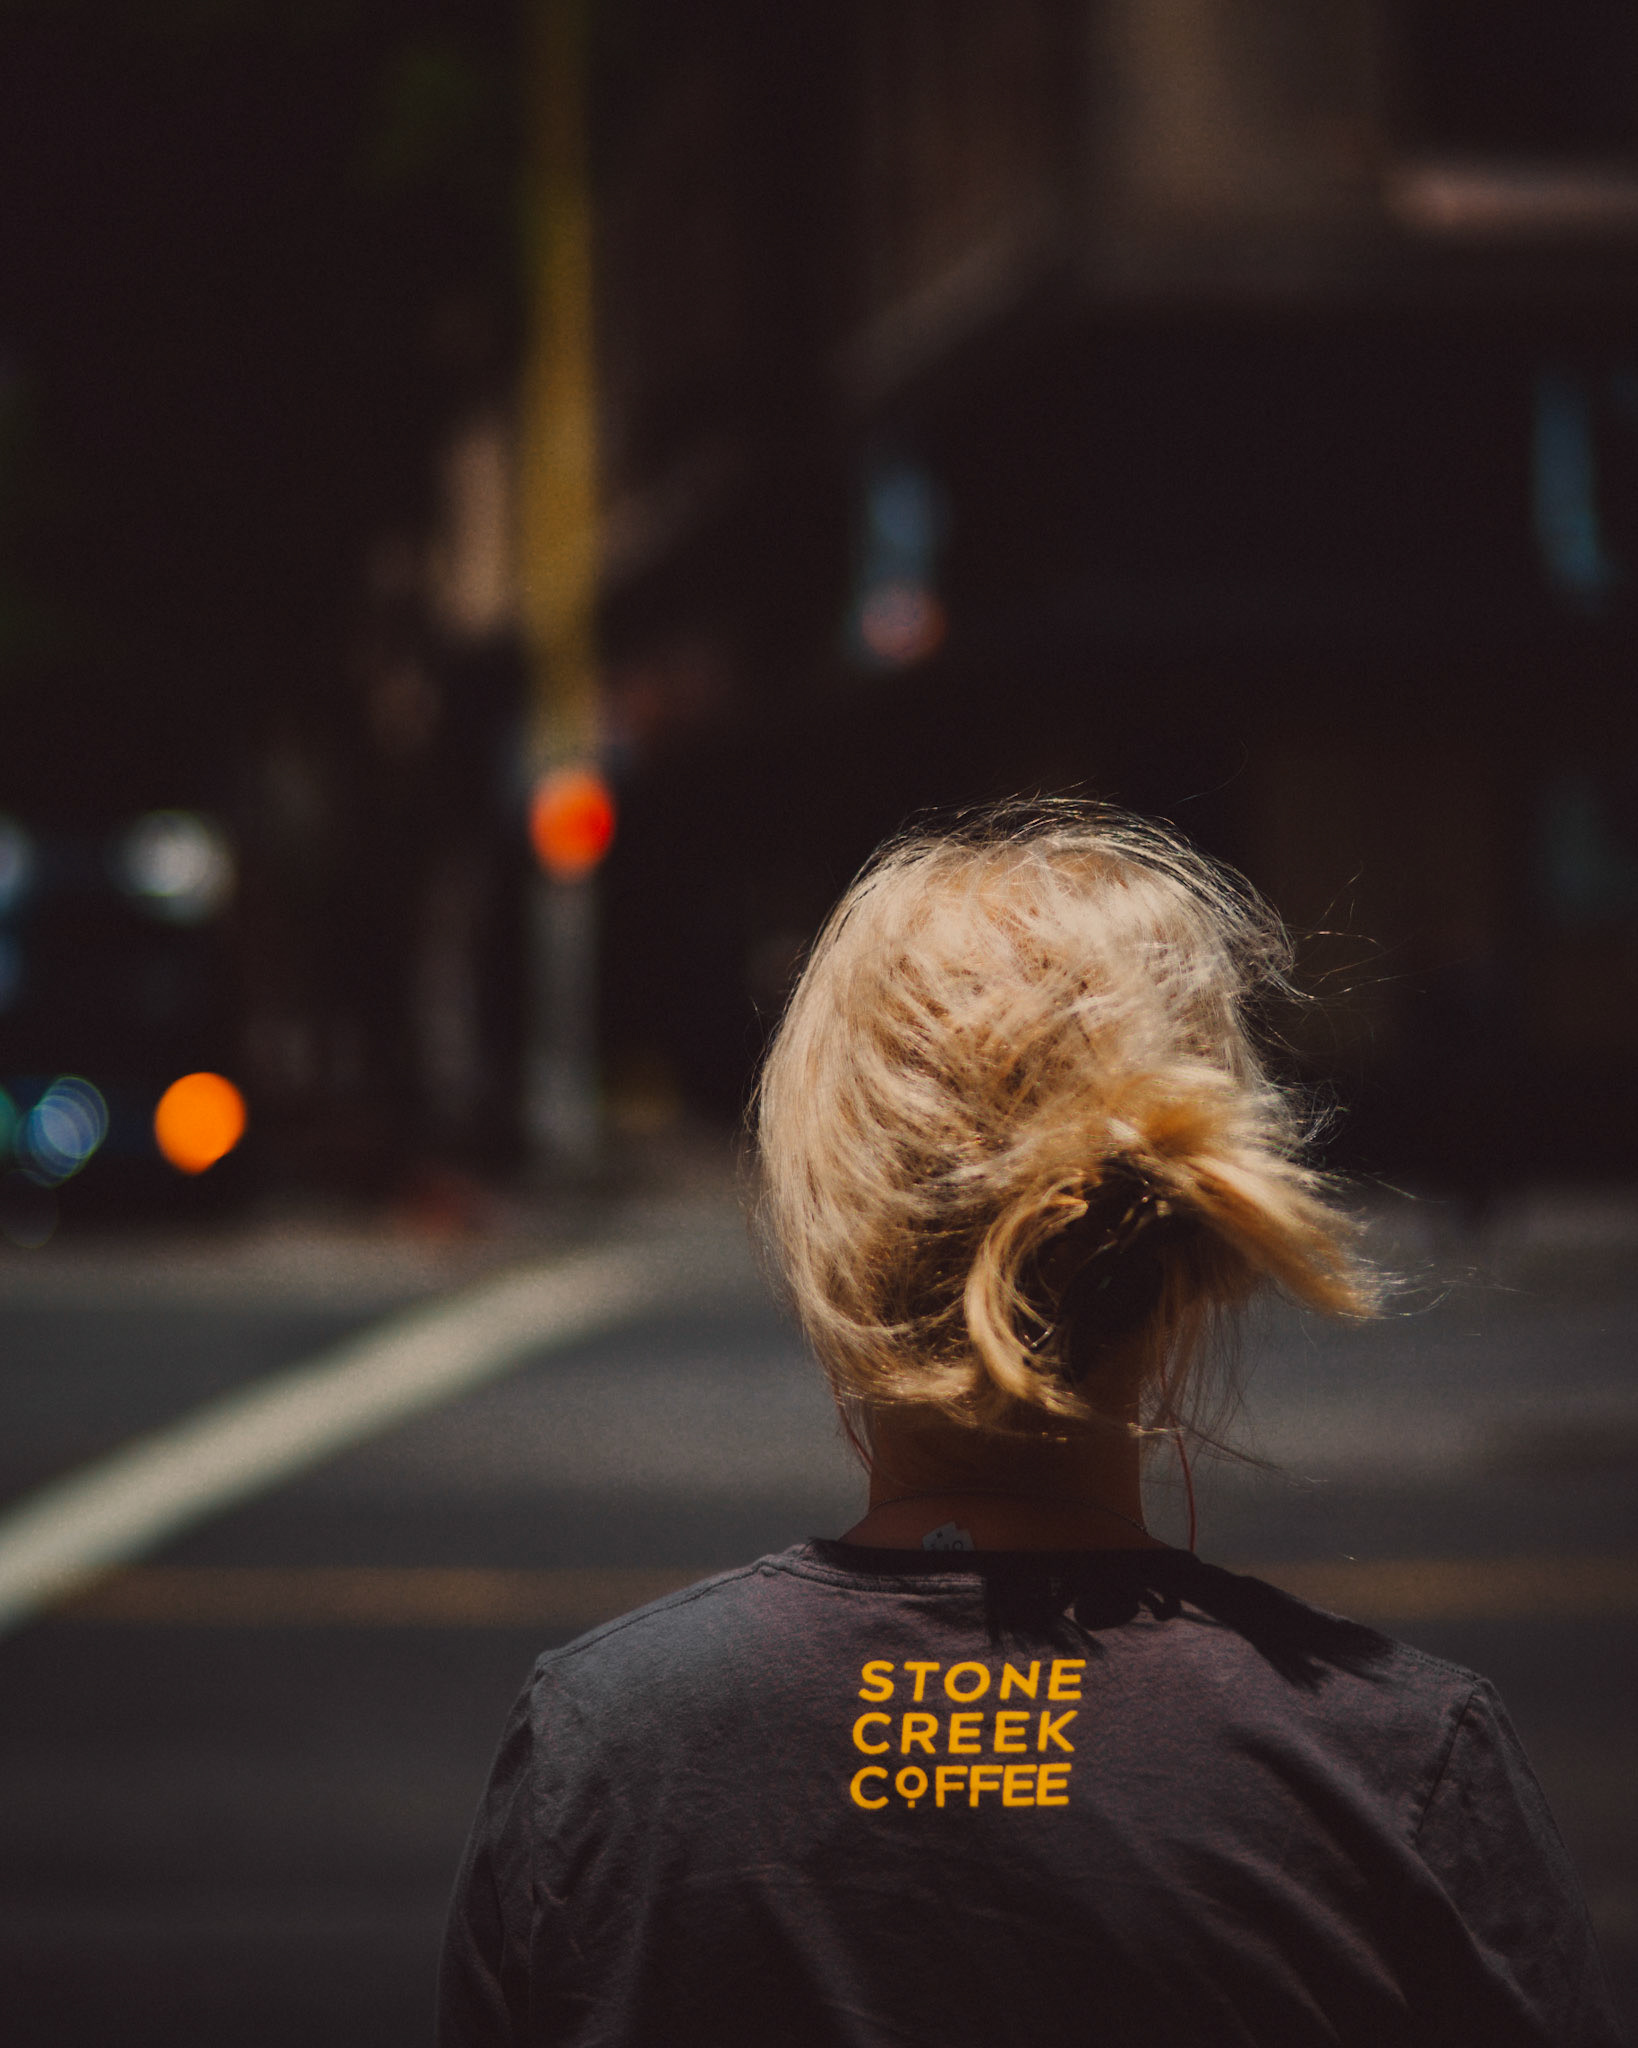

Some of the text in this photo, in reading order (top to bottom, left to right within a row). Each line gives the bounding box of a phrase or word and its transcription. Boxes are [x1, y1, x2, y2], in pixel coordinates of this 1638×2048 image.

[858, 1658, 1087, 1704] STONE
[852, 1709, 1079, 1755] CREEK
[849, 1762, 1073, 1810] COFFEE
